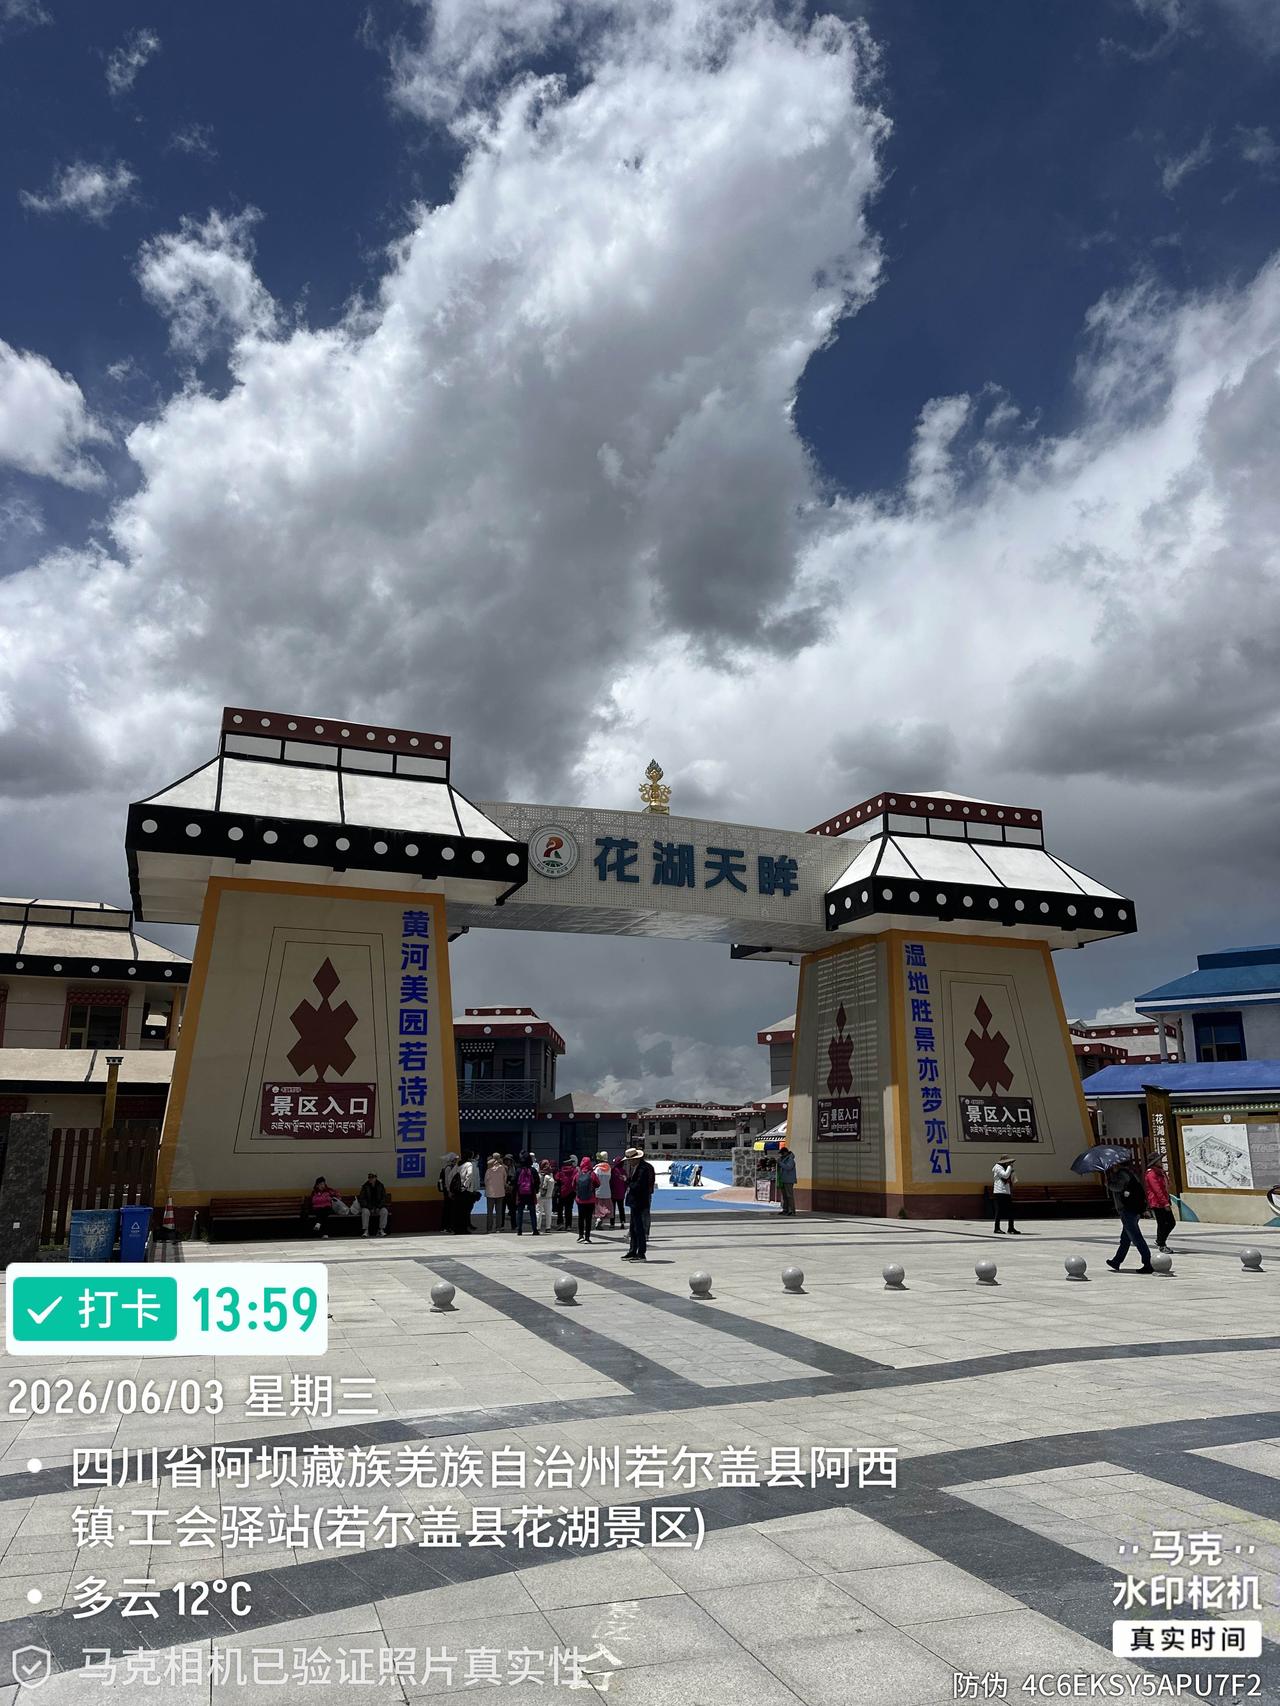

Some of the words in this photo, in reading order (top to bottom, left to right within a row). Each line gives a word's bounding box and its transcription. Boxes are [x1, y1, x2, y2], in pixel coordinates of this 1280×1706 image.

[594, 837, 799, 897] 花湖天眸
[397, 909, 431, 1178] 黄河美园若诗若画
[904, 943, 951, 1174] 湿地胜景亦梦亦幻
[270, 1096, 368, 1116] 景区入口
[966, 1105, 1031, 1123] 景区入口
